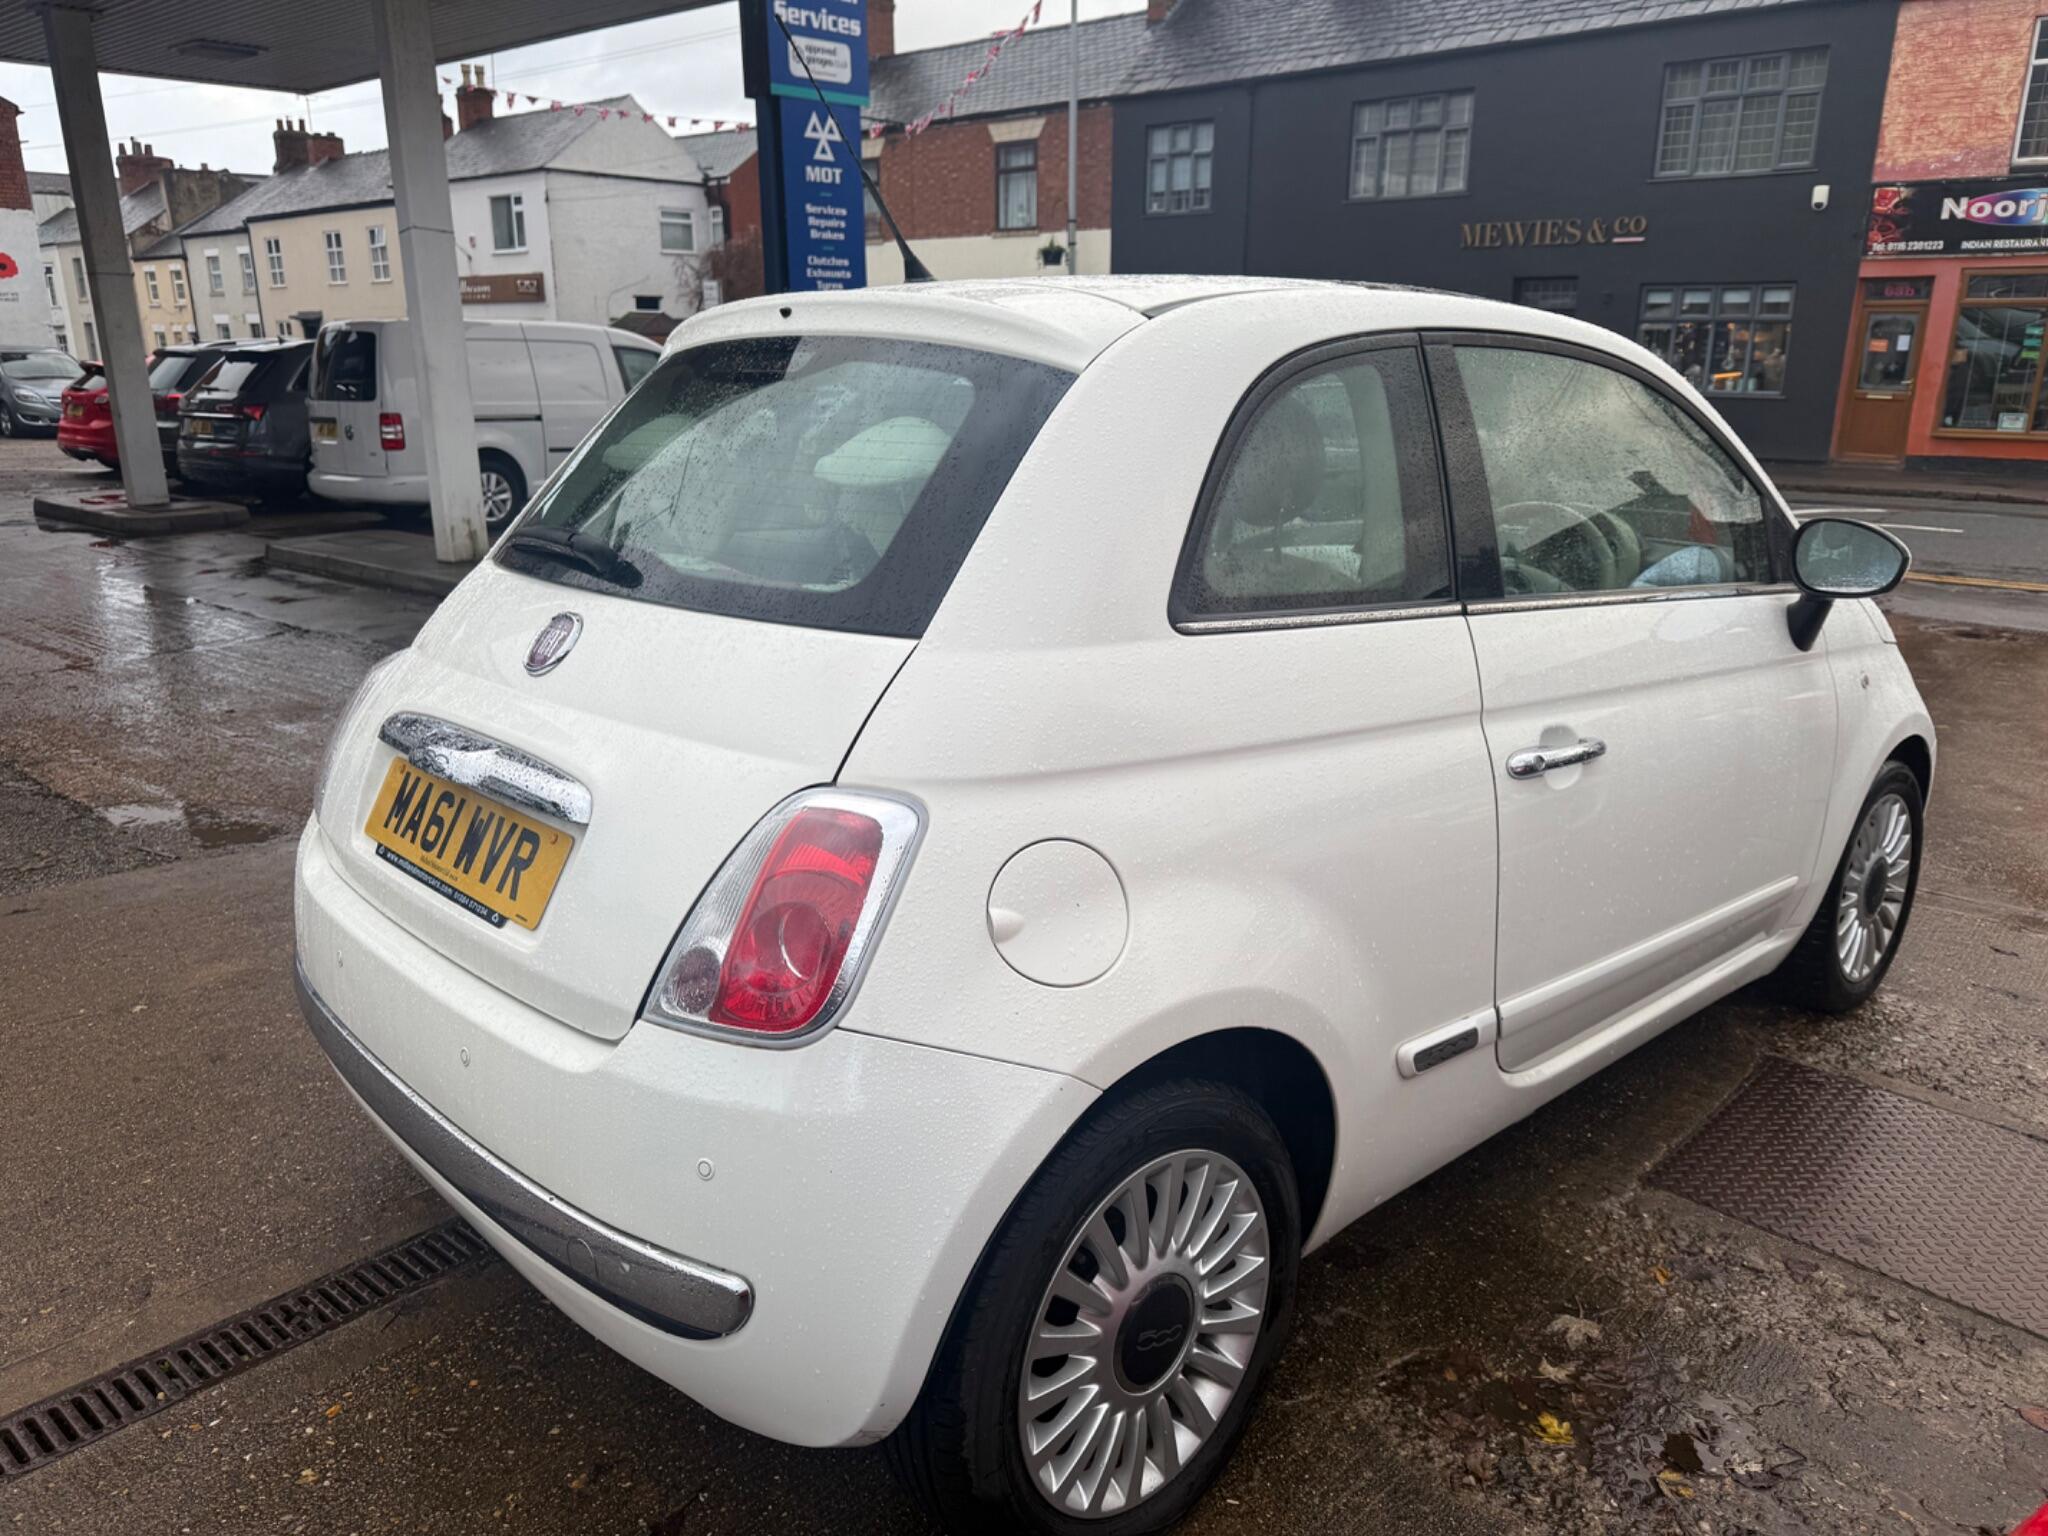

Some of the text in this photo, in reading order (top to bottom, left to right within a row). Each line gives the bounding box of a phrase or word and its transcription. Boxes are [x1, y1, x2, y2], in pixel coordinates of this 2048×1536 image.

[773, 0, 861, 37] Services
[805, 165, 843, 184] MOT
[805, 203, 847, 216] Services
[808, 216, 846, 228] Repairs
[810, 228, 845, 240] Brakes
[1460, 218, 1582, 248] MEWIES
[1586, 217, 1608, 244] &
[1961, 238, 2048, 250] INDIAN RESTAURAN
[807, 255, 850, 267] Clutches
[806, 267, 852, 279] Exhausts
[383, 770, 541, 901] MA61 WVR
